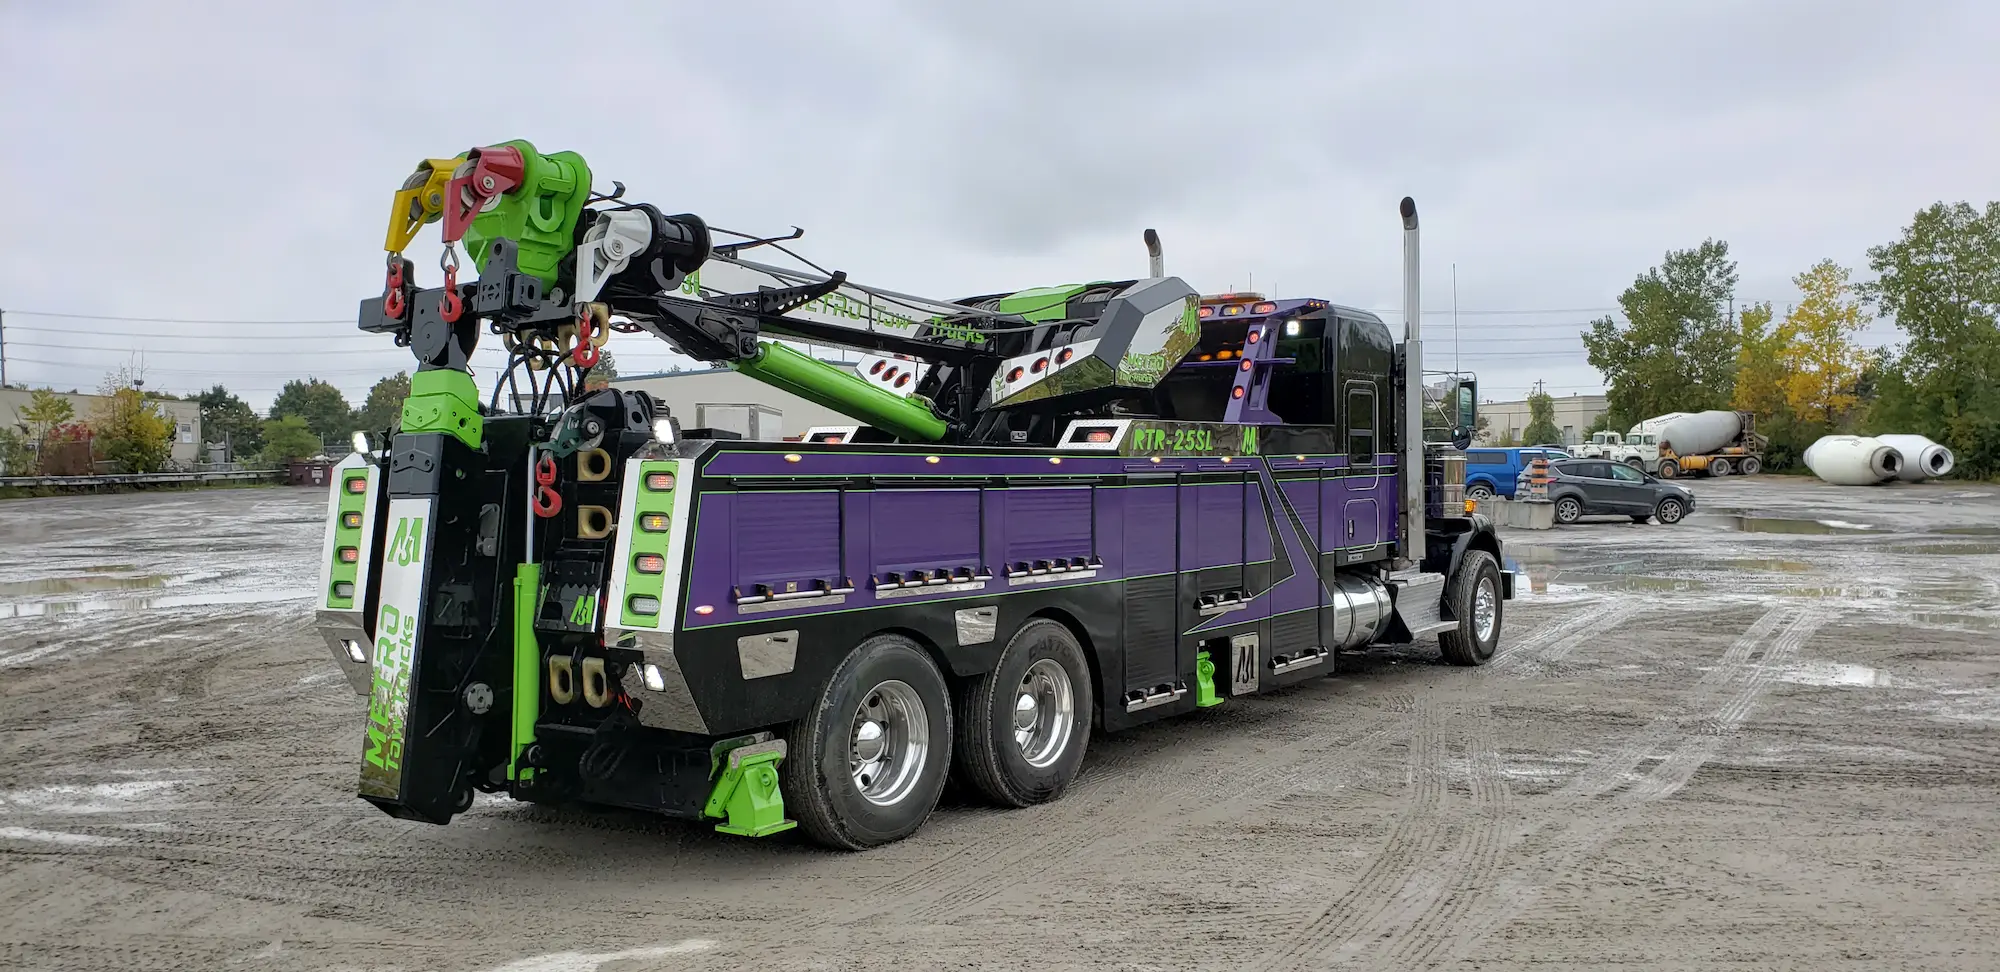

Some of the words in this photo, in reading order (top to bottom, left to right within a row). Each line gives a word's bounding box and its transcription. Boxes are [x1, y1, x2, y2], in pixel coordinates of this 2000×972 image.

[798, 293, 863, 320] ETRO
[1133, 428, 1214, 451] RTR-25SL
[366, 604, 400, 770] METRO
